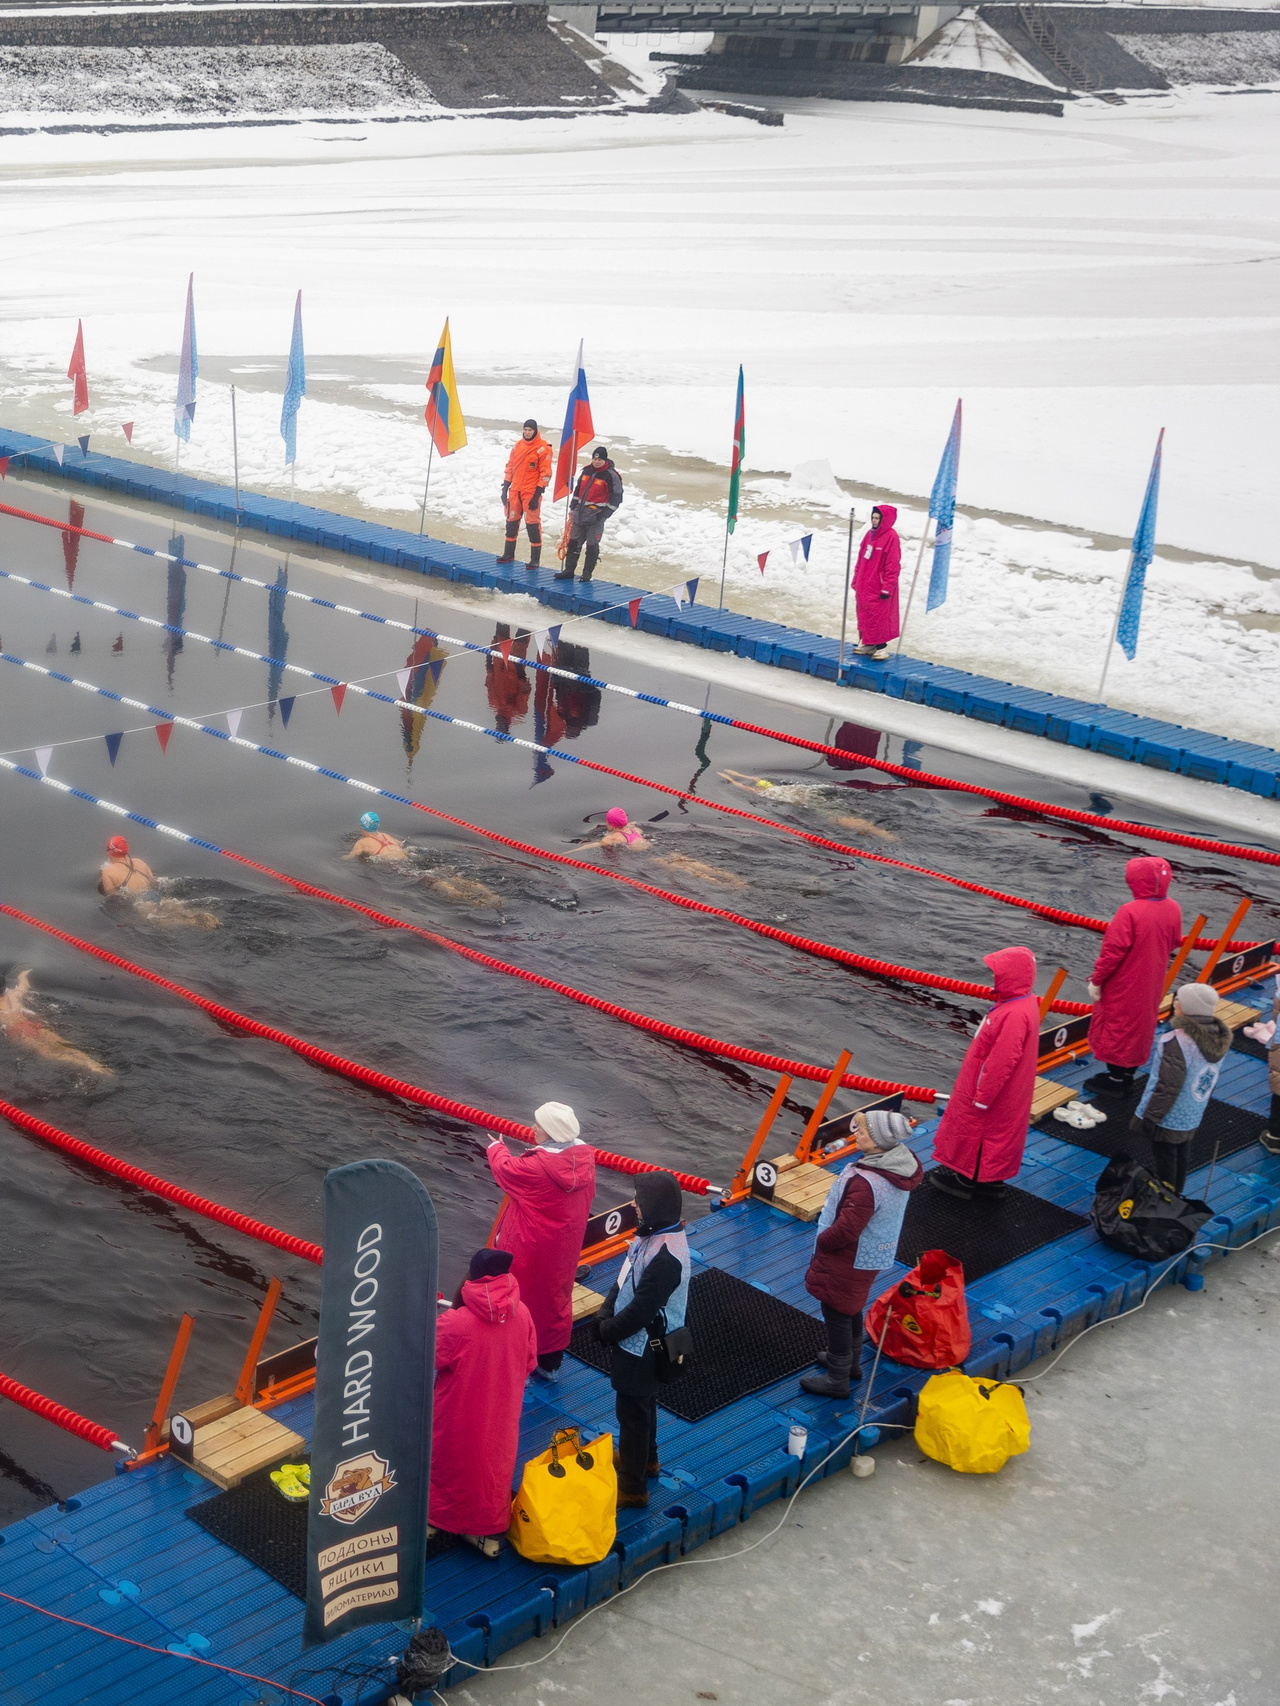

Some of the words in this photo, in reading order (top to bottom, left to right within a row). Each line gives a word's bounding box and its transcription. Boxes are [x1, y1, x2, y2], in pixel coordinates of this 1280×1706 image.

[1056, 1030, 1064, 1044] 4
[761, 1166, 772, 1183] 3
[608, 1215, 618, 1232] 2
[346, 1223, 383, 1347] WOOD
[341, 1350, 373, 1447] HARD
[176, 1421, 185, 1440] 1
[320, 1531, 394, 1568] ПОДДОНЫ
[328, 1561, 385, 1590] ЯЩИКИ
